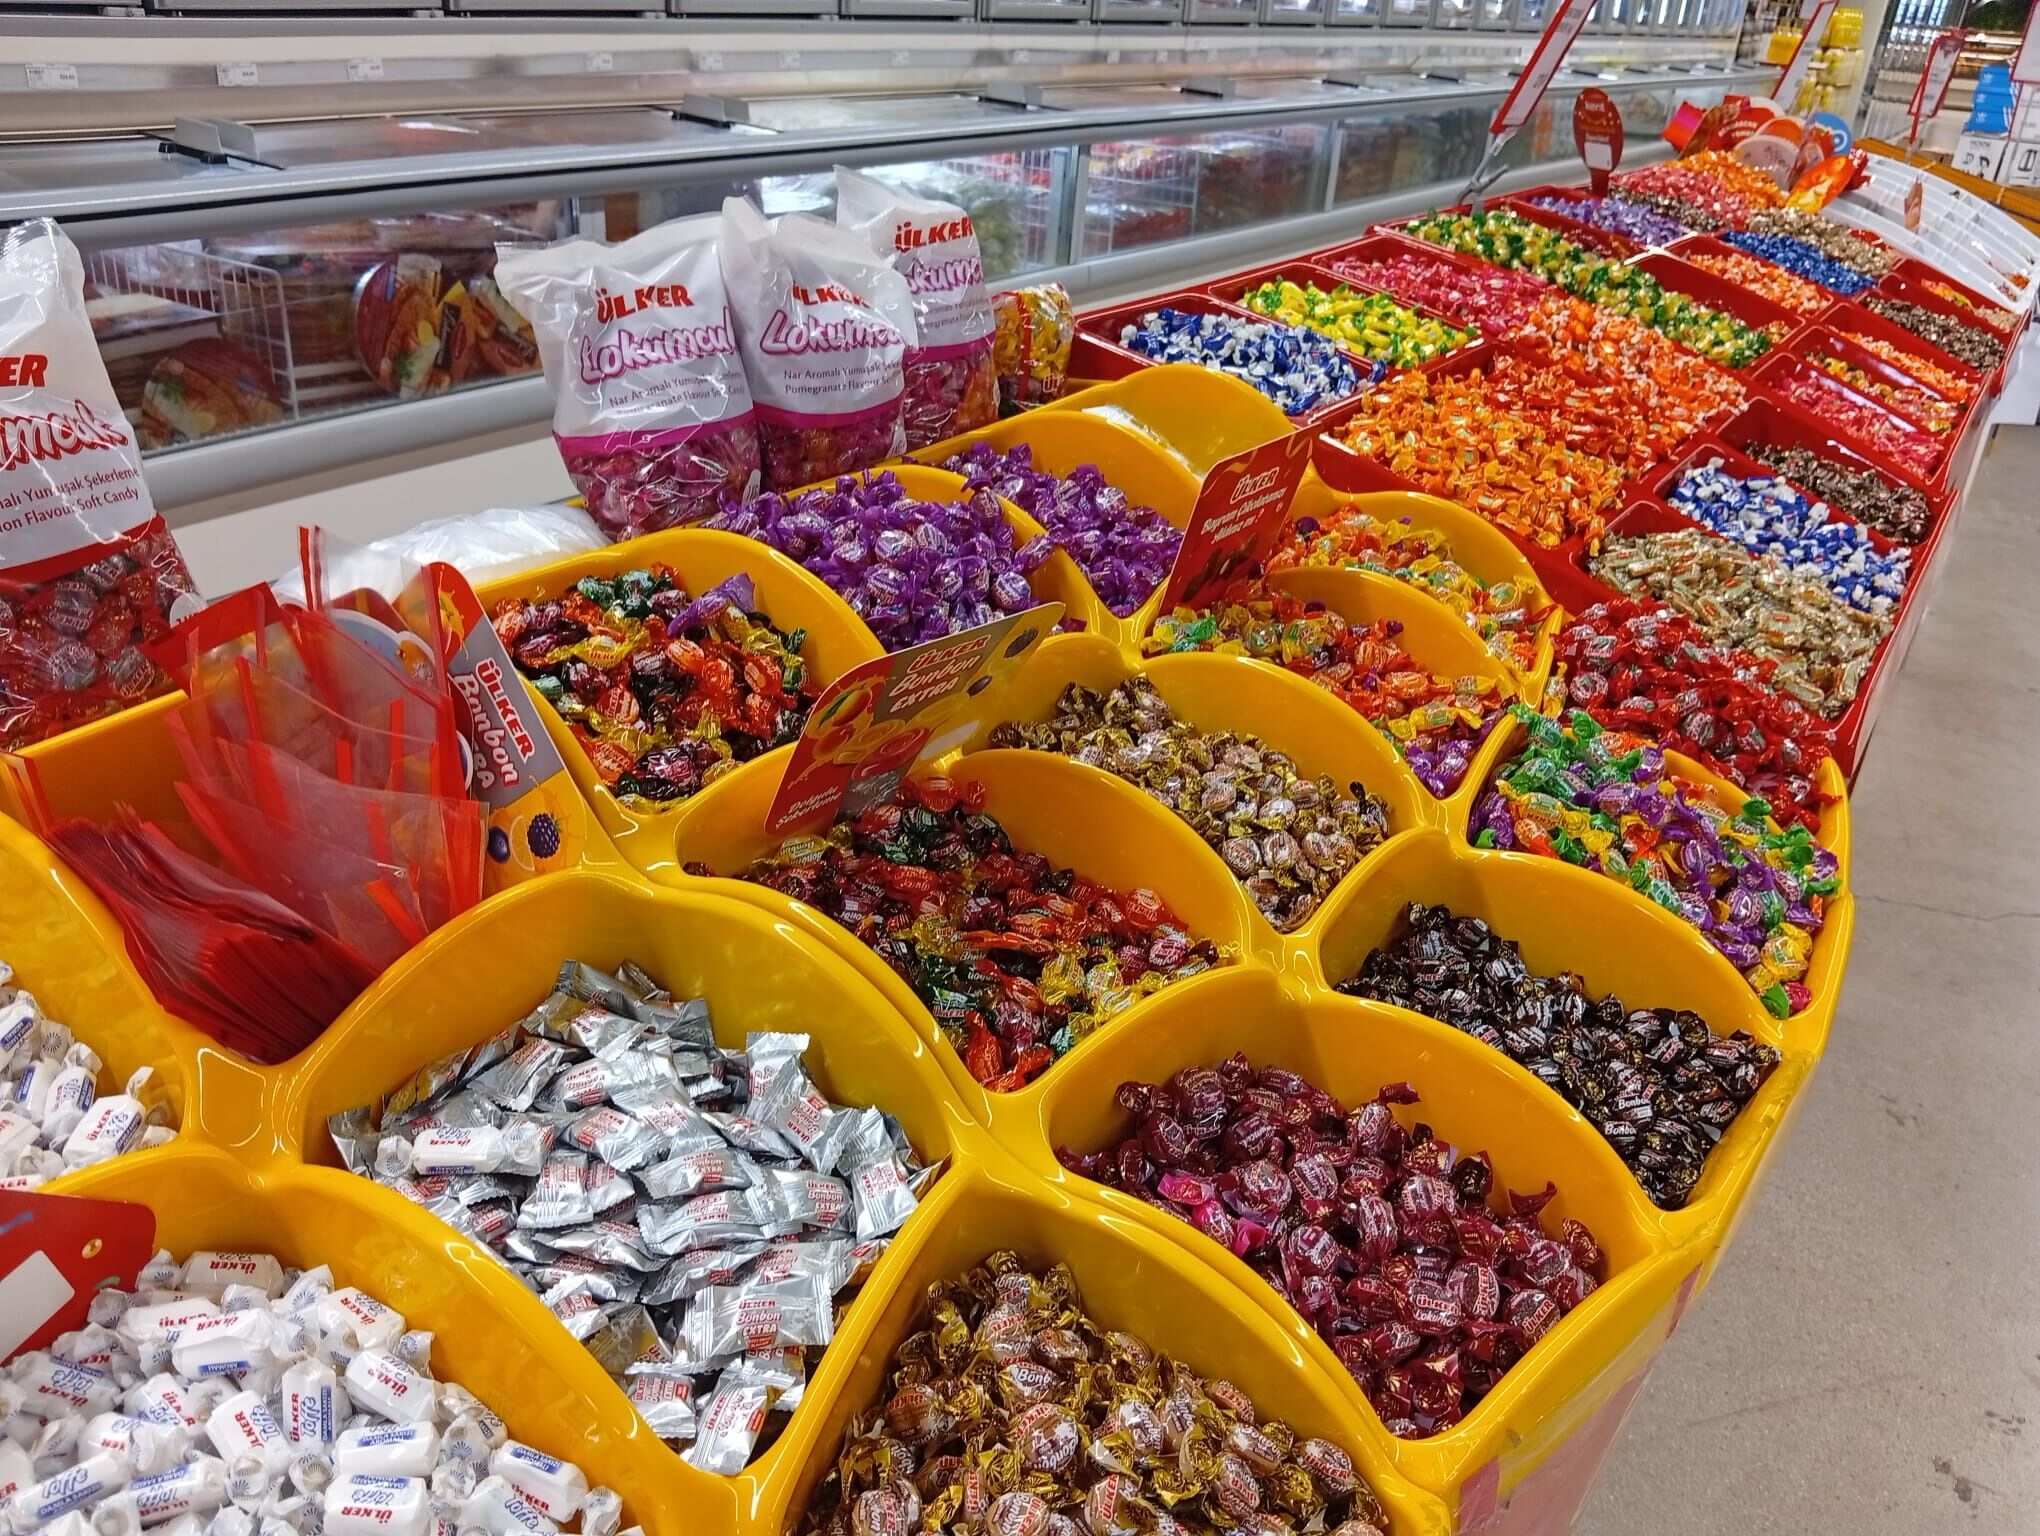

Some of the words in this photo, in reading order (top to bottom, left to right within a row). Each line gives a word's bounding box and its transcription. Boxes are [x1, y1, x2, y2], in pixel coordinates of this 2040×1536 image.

[597, 284, 694, 323] ÜLKER
[784, 370, 801, 380] Nar
[804, 367, 840, 379] Aromalı
[785, 381, 846, 394] Pomegranate
[609, 395, 628, 408] Nar
[23, 476, 84, 502] Yumuşak
[84, 468, 140, 490] Şekerleme
[1230, 467, 1279, 504] ÜLKER
[25, 503, 75, 525] Flavour
[77, 495, 102, 511] Soft
[104, 487, 139, 505] Candy
[907, 635, 991, 673] ÜLKER
[889, 655, 982, 697] Bonbon
[890, 676, 957, 712] EXTRA
[476, 657, 535, 764] ÜLKER
[454, 673, 520, 787] Bonbon
[87, 1109, 113, 1142] ÜLKER
[788, 1121, 810, 1143] ÜLKER
[808, 1189, 843, 1201] Bonbon
[816, 1202, 843, 1212] EXTRA
[209, 1261, 256, 1274] ÜLKER
[1000, 1286, 1021, 1300] KER
[1479, 1267, 1490, 1311] ÜLKER
[340, 1296, 376, 1326] ÜLKER
[737, 1310, 781, 1325] Bonbon
[1417, 1295, 1459, 1315] ÜLKER
[1522, 1300, 1555, 1334] ÜLKER
[743, 1324, 777, 1336] EXTRA
[79, 1354, 111, 1365] KER
[38, 1385, 89, 1407] ÜLKER
[52, 1369, 94, 1396] Toffe
[162, 1391, 196, 1427] ÜLKR
[250, 1405, 280, 1441] Toffe
[290, 1392, 299, 1443] ÜLKER
[300, 1396, 320, 1438] Toffe
[706, 1396, 726, 1430] ÜLKER
[101, 1438, 126, 1449] KER
[1305, 1453, 1349, 1480] ÜLKER
[41, 1467, 88, 1499] Toffe
[40, 1495, 71, 1515] DAMLA
[341, 1506, 393, 1524] ÜLKER
[505, 1494, 539, 1529] Toffe
